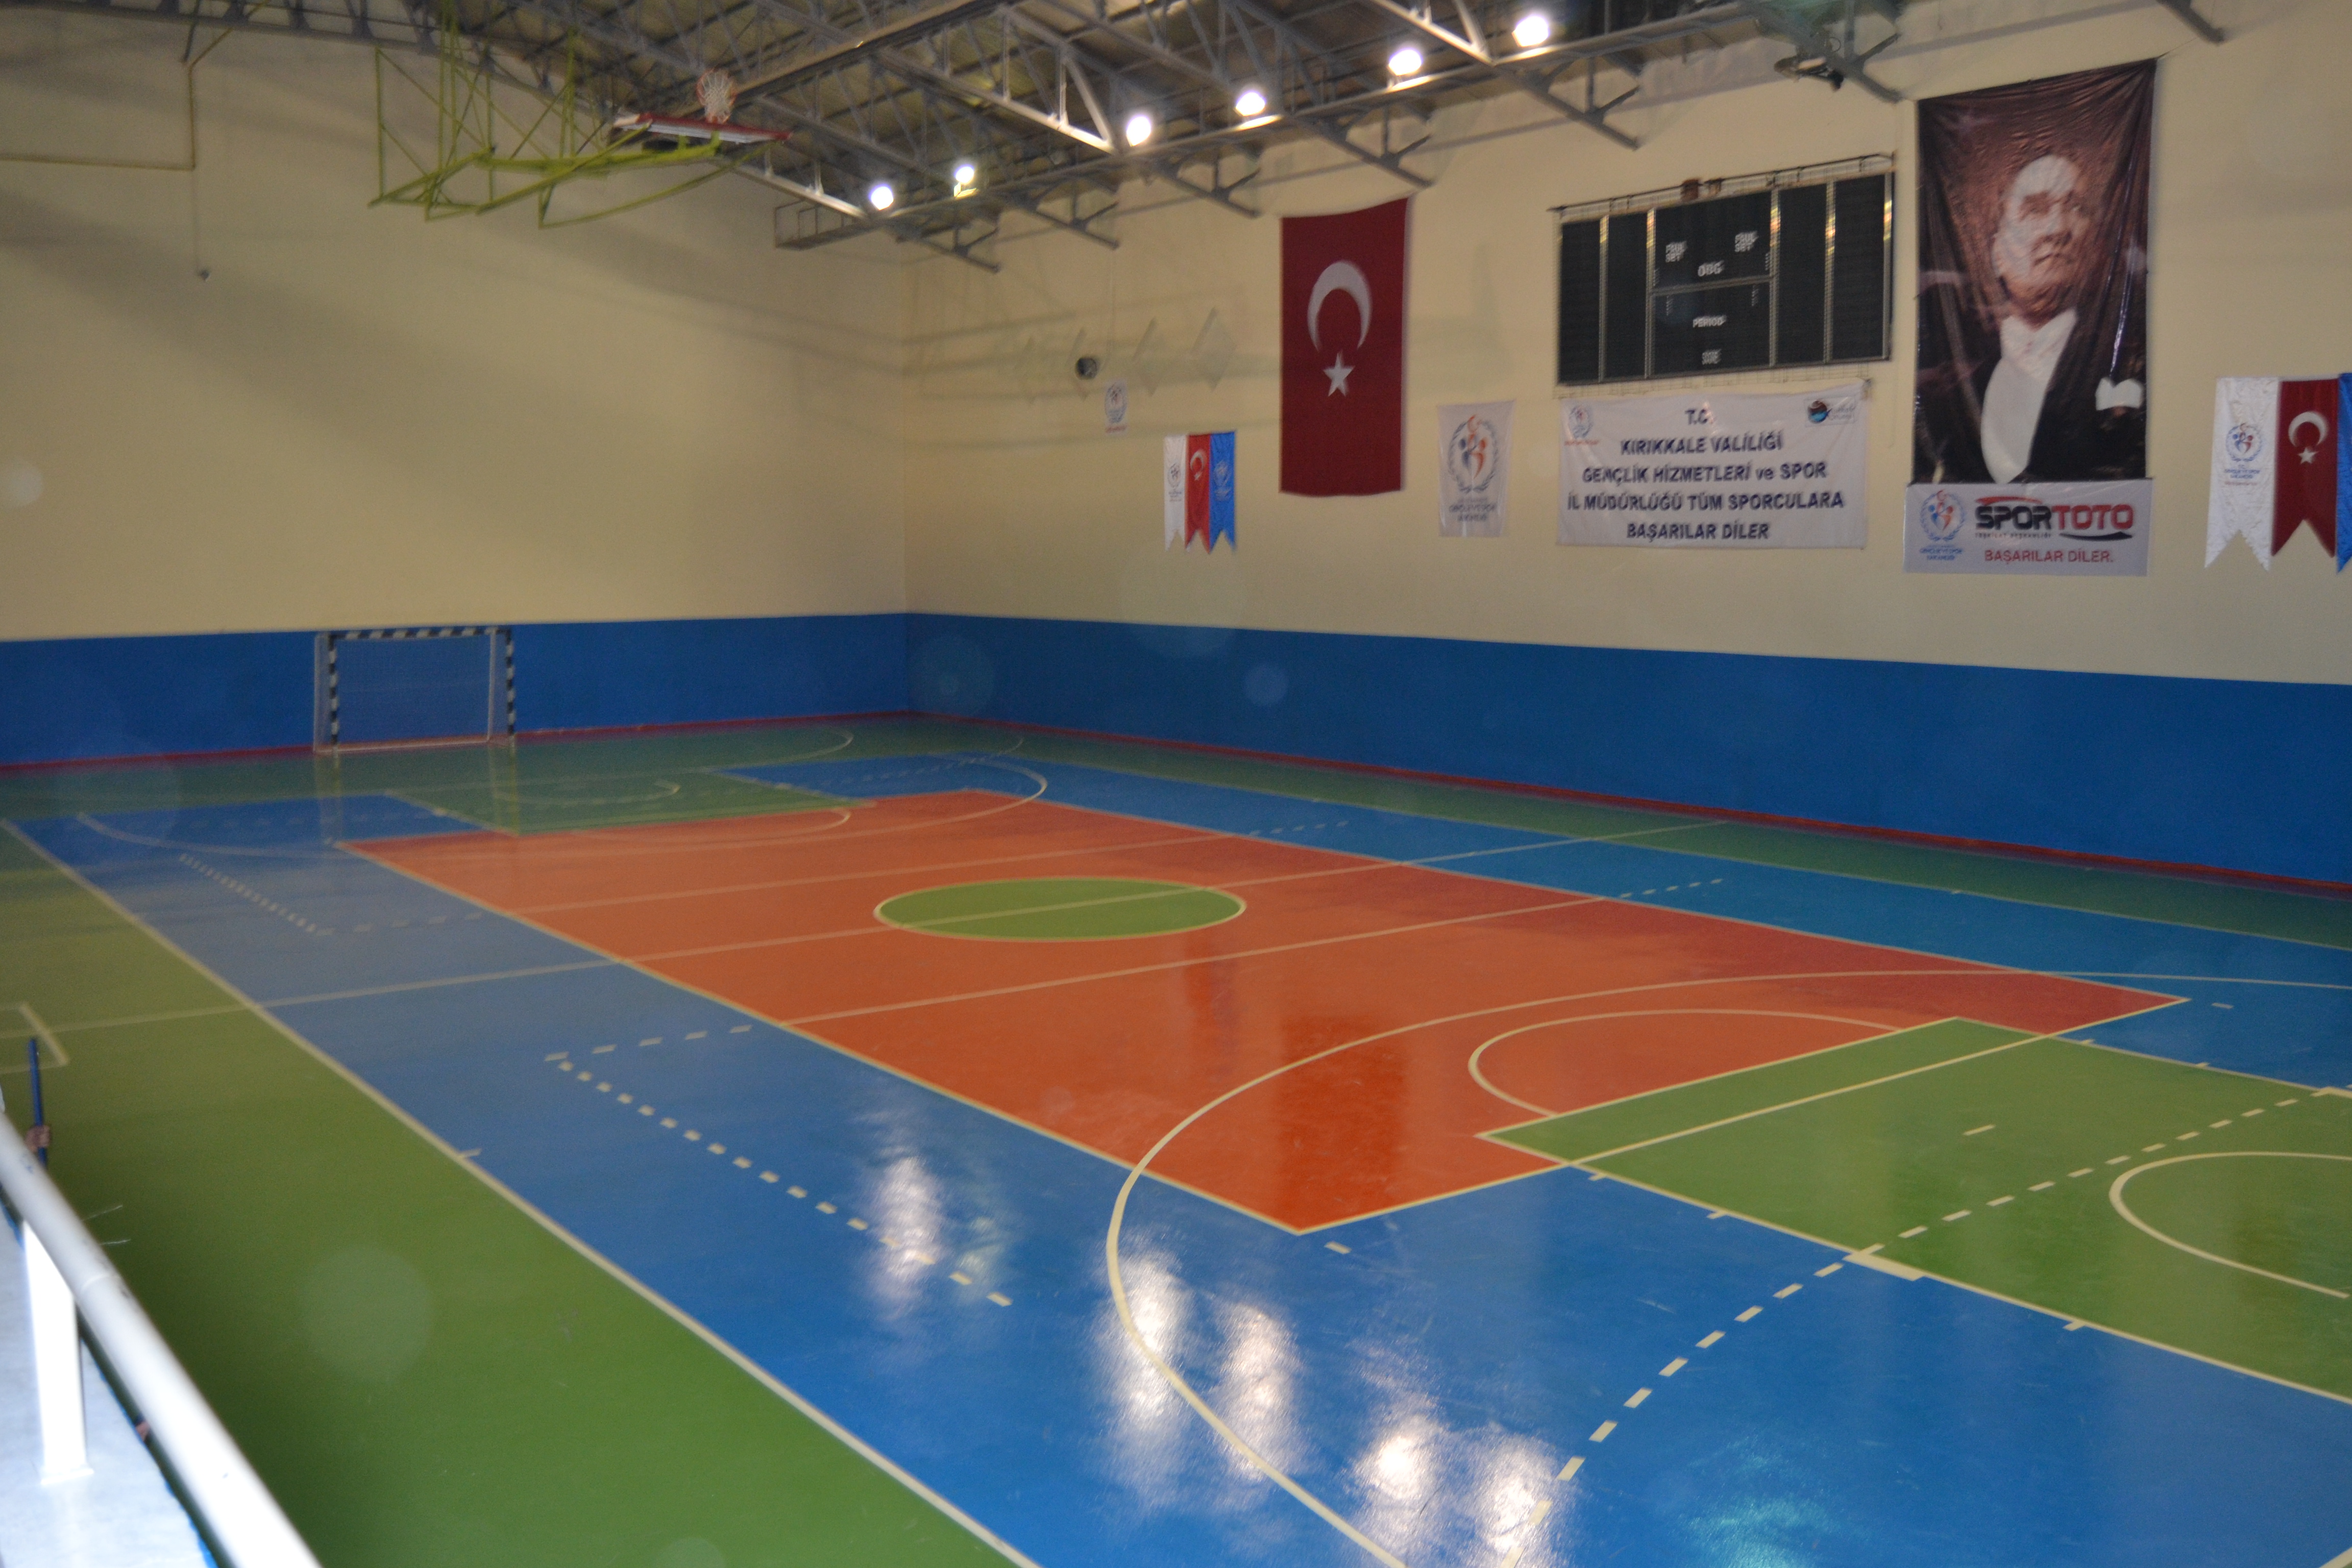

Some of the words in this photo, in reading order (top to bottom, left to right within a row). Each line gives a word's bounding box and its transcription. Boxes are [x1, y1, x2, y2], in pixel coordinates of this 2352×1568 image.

[1693, 315, 1727, 327] PERIOD
[1621, 436, 1706, 455] KIRIKKALE
[1711, 430, 1783, 453] VALİLİĞİ
[1583, 462, 1649, 486] GENÇLİK
[1653, 460, 1752, 483] HİZMETLERİ
[1755, 467, 1774, 480] ve
[1780, 461, 1827, 480] SPOR
[1567, 490, 1580, 510] İL
[1584, 491, 1682, 510] MÜDÜRLÜĞÜ
[1687, 492, 1722, 510] TÜM
[1728, 491, 1844, 510] SPORCULARA
[1626, 522, 1717, 542] BAŞARILAR
[1721, 519, 1770, 539] DİLER
[1984, 550, 2064, 565] BAŞARILAR
